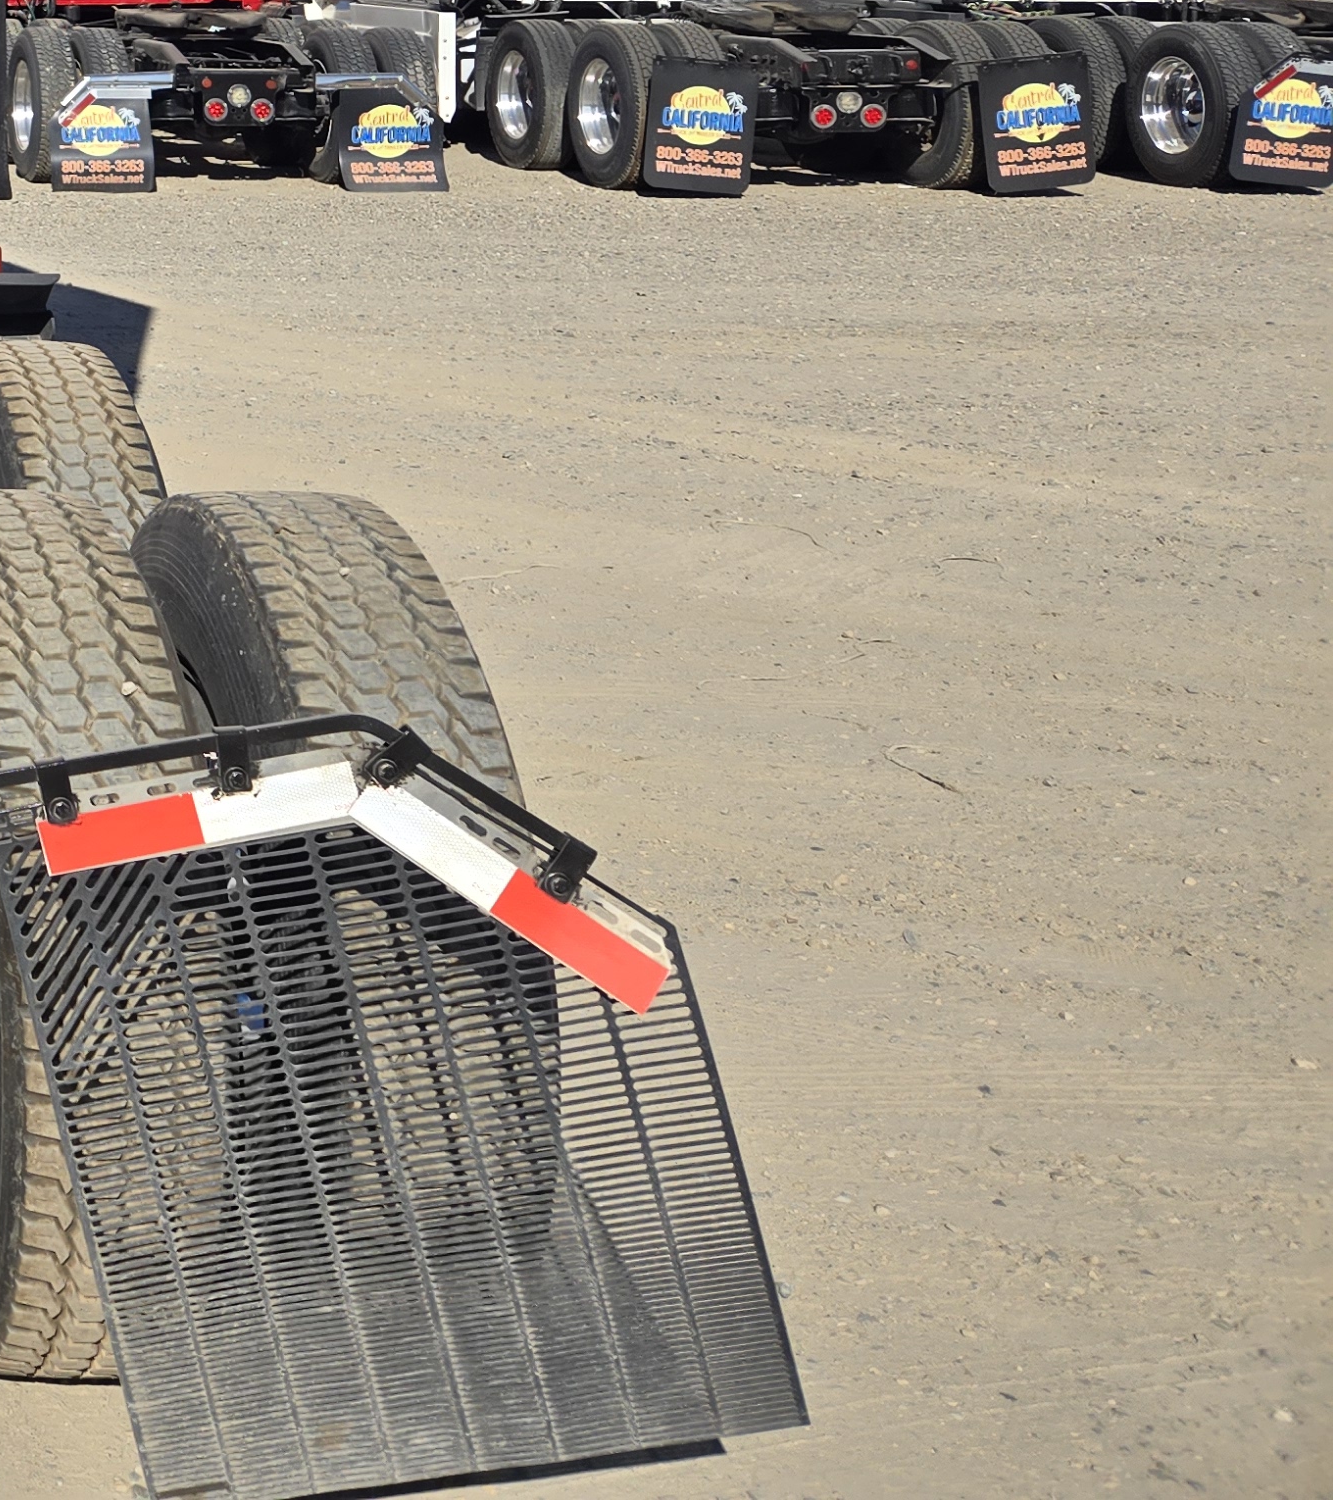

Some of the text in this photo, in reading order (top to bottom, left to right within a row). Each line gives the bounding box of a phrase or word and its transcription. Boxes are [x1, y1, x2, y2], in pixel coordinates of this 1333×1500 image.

[671, 88, 724, 109] Central
[1002, 82, 1056, 110] Central
[71, 106, 116, 127] entral
[359, 105, 411, 127] Central
[662, 106, 744, 133] CALIFORNIA
[996, 104, 1082, 130] CALIFORNIA
[1252, 99, 1333, 127] CALIFORNIA
[61, 125, 141, 143] CALIFORNIA
[351, 124, 431, 144] CALIFORNIA
[656, 145, 743, 166] 800-366-3263
[998, 141, 1086, 163] 800-366-3263
[1244, 138, 1332, 160] 800-366-3263
[61, 159, 145, 173] 800-366-3263
[351, 160, 436, 174] 800-366-3263
